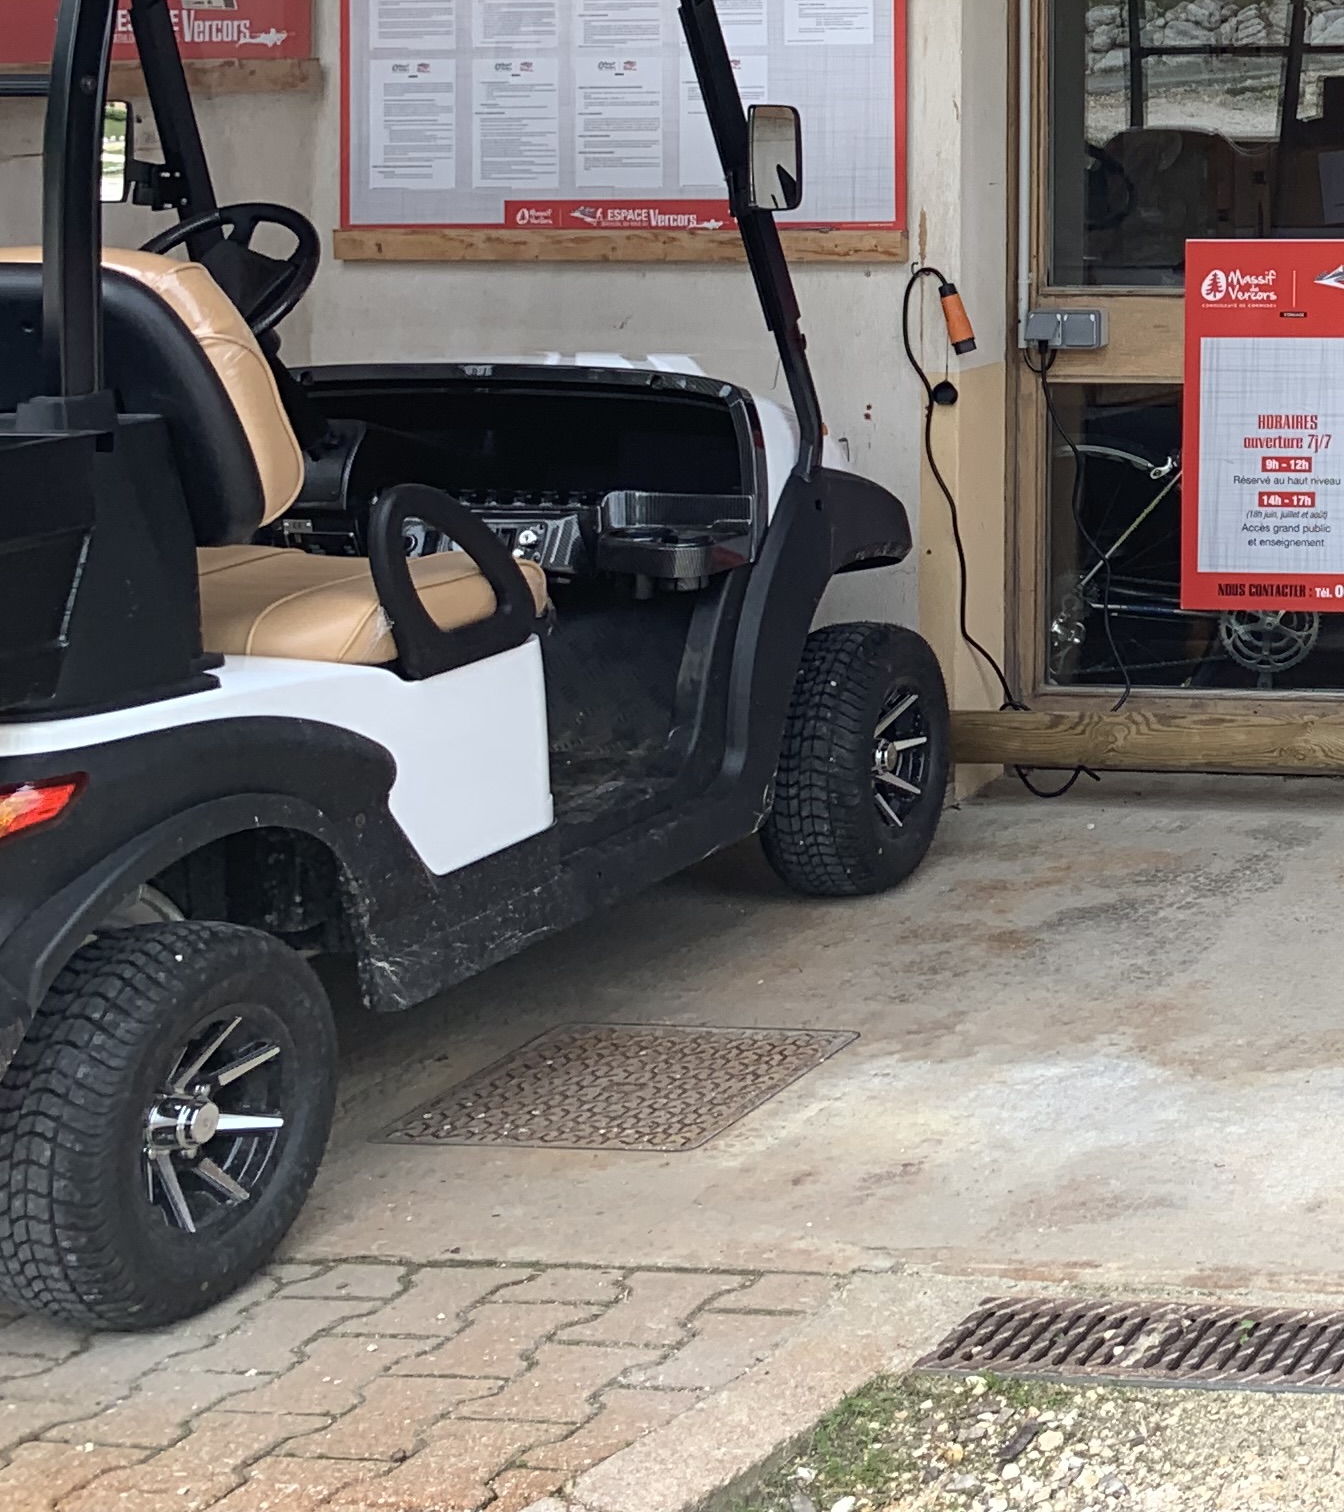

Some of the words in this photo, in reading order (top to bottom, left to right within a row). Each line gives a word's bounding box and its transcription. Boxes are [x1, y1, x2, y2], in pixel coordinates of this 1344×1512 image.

[182, 9, 250, 42] Vercors
[607, 209, 648, 220] ESPACE
[650, 209, 697, 227] Vercors
[1228, 269, 1276, 285] Massif
[1228, 285, 1277, 301] Vercors
[1258, 415, 1318, 430] HORAIRES
[1244, 435, 1303, 449] ouverture
[1308, 434, 1332, 453] 7j/7
[1265, 459, 1279, 469] 9h
[1290, 459, 1309, 470] 12h
[1233, 475, 1271, 485] Réservé
[1274, 477, 1285, 485] au
[1288, 476, 1308, 485] haut
[1311, 476, 1341, 485] niveau
[1262, 495, 1281, 505] 14h
[1292, 495, 1311, 506] 17h
[1242, 523, 1270, 532] Accès
[1273, 524, 1299, 534] grand
[1303, 524, 1331, 534] public
[1248, 538, 1257, 546] et
[1259, 539, 1325, 548] enseignement
[1218, 583, 1246, 597] NOUS
[1248, 584, 1306, 598] CONTACTER
[1315, 587, 1333, 598] Tél.
